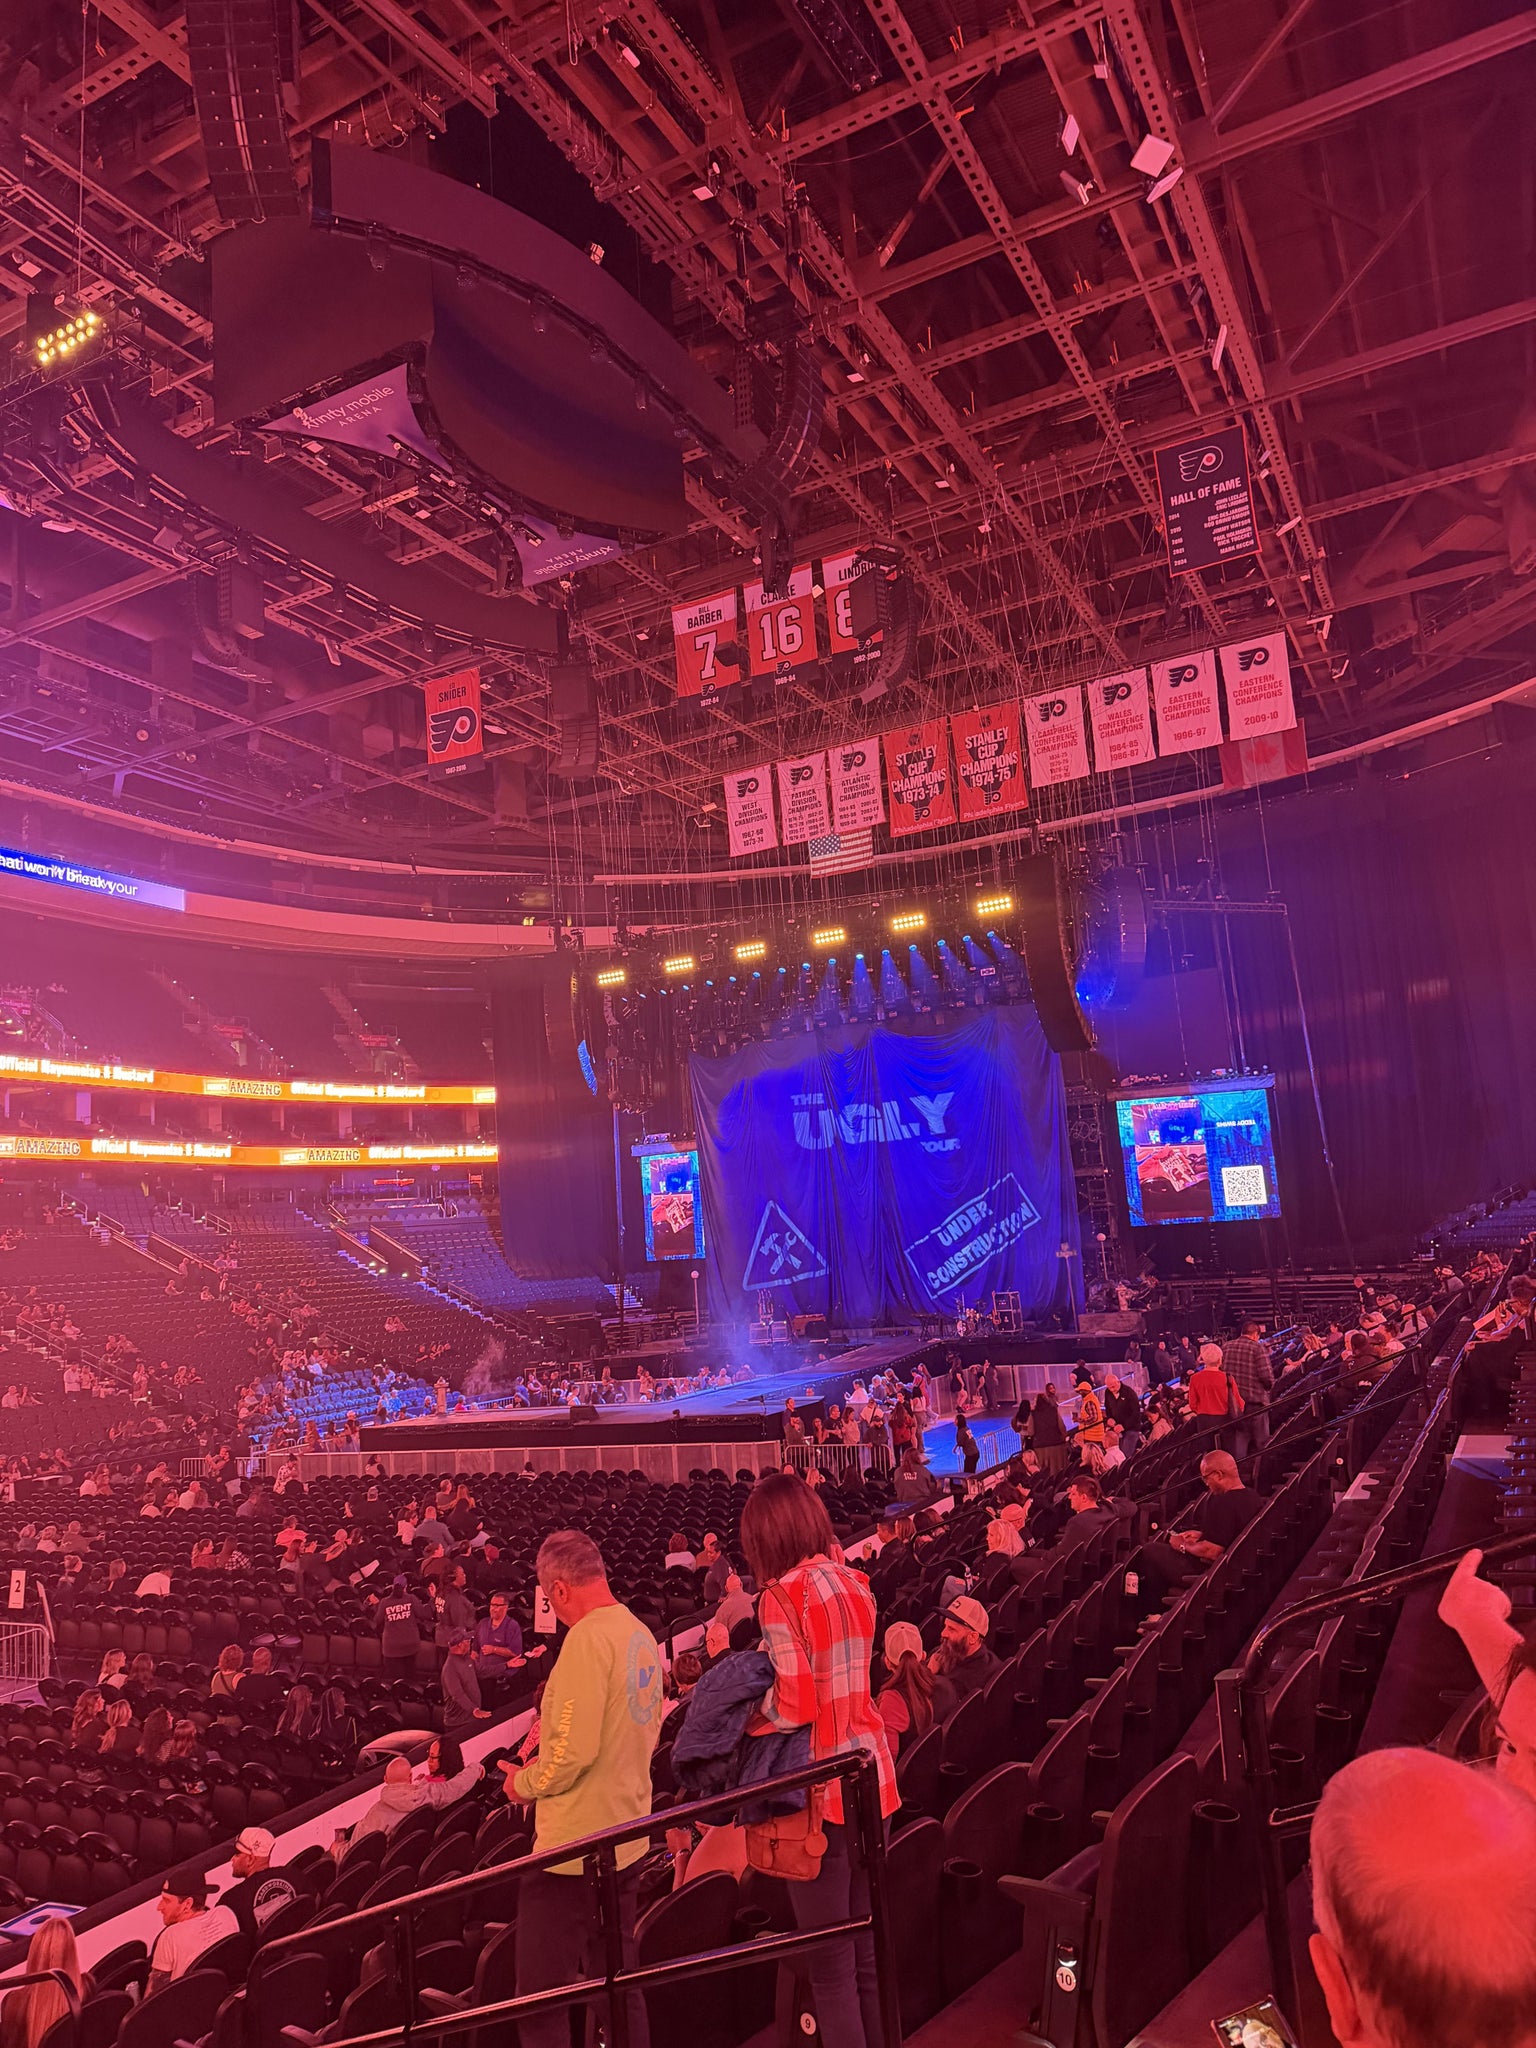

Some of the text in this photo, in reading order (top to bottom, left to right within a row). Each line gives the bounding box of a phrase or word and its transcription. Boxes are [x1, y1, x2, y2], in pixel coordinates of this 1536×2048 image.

[348, 386, 394, 411] mobile
[339, 406, 382, 427] ARENA
[1170, 477, 1242, 507] HALL OF FAME
[534, 545, 614, 576] xfinity mobile
[545, 548, 584, 563] ARENA
[839, 561, 878, 581] LINDR
[698, 605, 710, 614] BILL
[687, 609, 722, 629] BARBER
[760, 604, 803, 661] 16
[694, 630, 717, 680] 7
[1232, 679, 1284, 698] CONFERENCE
[1239, 674, 1275, 688] EASTERN
[438, 687, 467, 702] SNIDER
[1169, 690, 1203, 704] EASTERN
[1235, 688, 1283, 705] CHAMPIONS
[1162, 696, 1211, 714] CONFERENCE
[1107, 709, 1132, 721] WALES
[1165, 705, 1211, 721] CHAMPIONS
[1244, 710, 1279, 725] 2009-10
[1098, 713, 1144, 731] CONFERENCE
[965, 726, 1009, 749] STANLEY
[1037, 724, 1075, 739] CAMPBELL
[1100, 722, 1144, 739] CHAMPIONS
[1174, 727, 1207, 741] 1996-97
[1034, 730, 1078, 748] CONFERENCE
[977, 743, 999, 760] CUP
[1036, 739, 1078, 755] CHAMPIONS
[907, 760, 928, 777] CUP
[960, 750, 1019, 777] CHAMPIONS
[841, 775, 871, 787] ATLANTIC
[891, 768, 947, 793] CHAMPIONS
[971, 767, 1012, 788] 1974-75
[791, 788, 816, 800] PATRICK
[840, 787, 876, 802] CHAMPIONS
[843, 782, 870, 794] DIVISION
[902, 783, 940, 804] 1973-74
[741, 801, 757, 811] WEST
[788, 801, 822, 814] CHAMPIONS
[791, 796, 817, 806] DIVISION
[735, 813, 768, 827] CHAMPIONS
[738, 808, 763, 819] DIVISION
[108, 882, 138, 896] your
[230, 1081, 281, 1096] AMAZING
[791, 1093, 824, 1106] THE
[793, 1091, 954, 1150] UGLY
[17, 1140, 80, 1155] AMAZING
[308, 1150, 360, 1161] AMAZING
[937, 1201, 993, 1247] UNDER
[926, 1202, 1033, 1289] CONSTRUCTION
[15, 1580, 21, 1592] 2
[386, 1603, 412, 1615] EVENT
[542, 1597, 550, 1613] 3
[387, 1611, 411, 1622] STAFF
[1059, 1971, 1072, 1986] 10
[805, 2018, 811, 2029] 9
